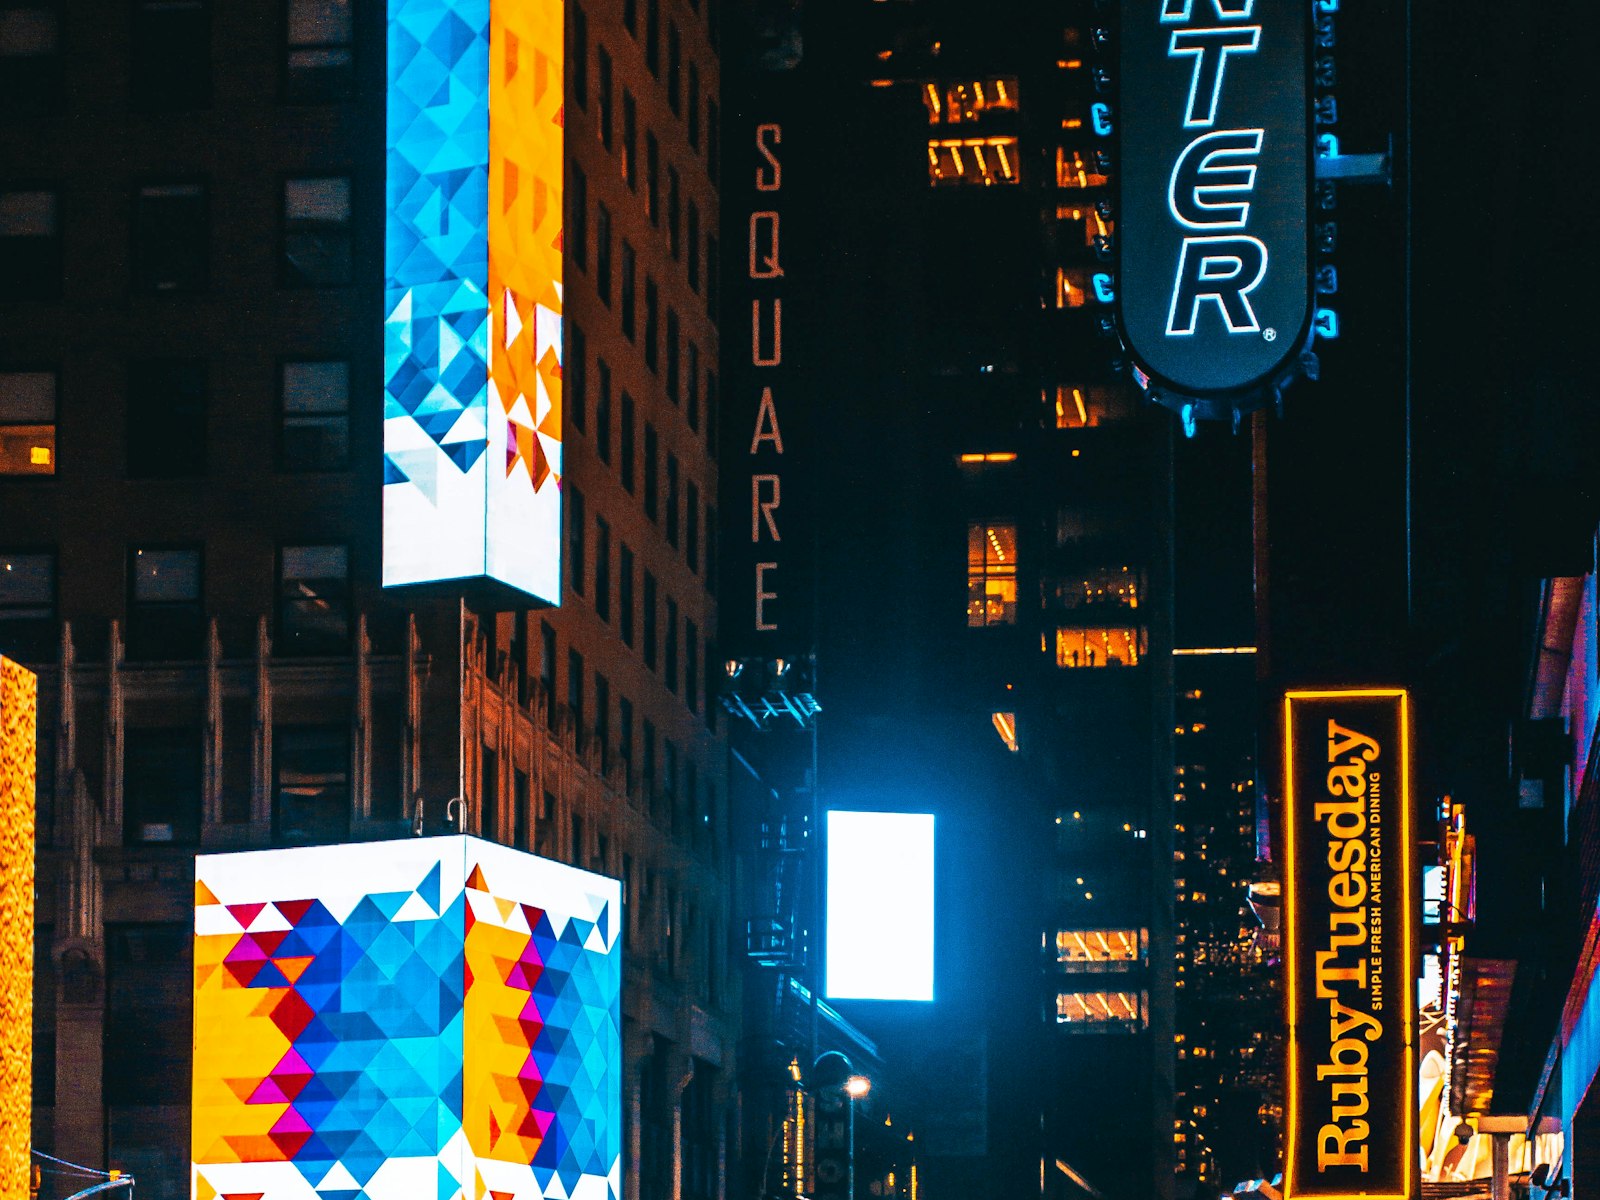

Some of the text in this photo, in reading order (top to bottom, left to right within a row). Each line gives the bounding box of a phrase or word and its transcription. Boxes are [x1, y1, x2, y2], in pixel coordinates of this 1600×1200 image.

[1159, 0, 1270, 339] TER
[748, 122, 785, 632] SQUARE
[1313, 718, 1382, 1174] Ruby Tuesday
[1371, 772, 1383, 1011] SIMPLE FRESH AMERICAN DINING
